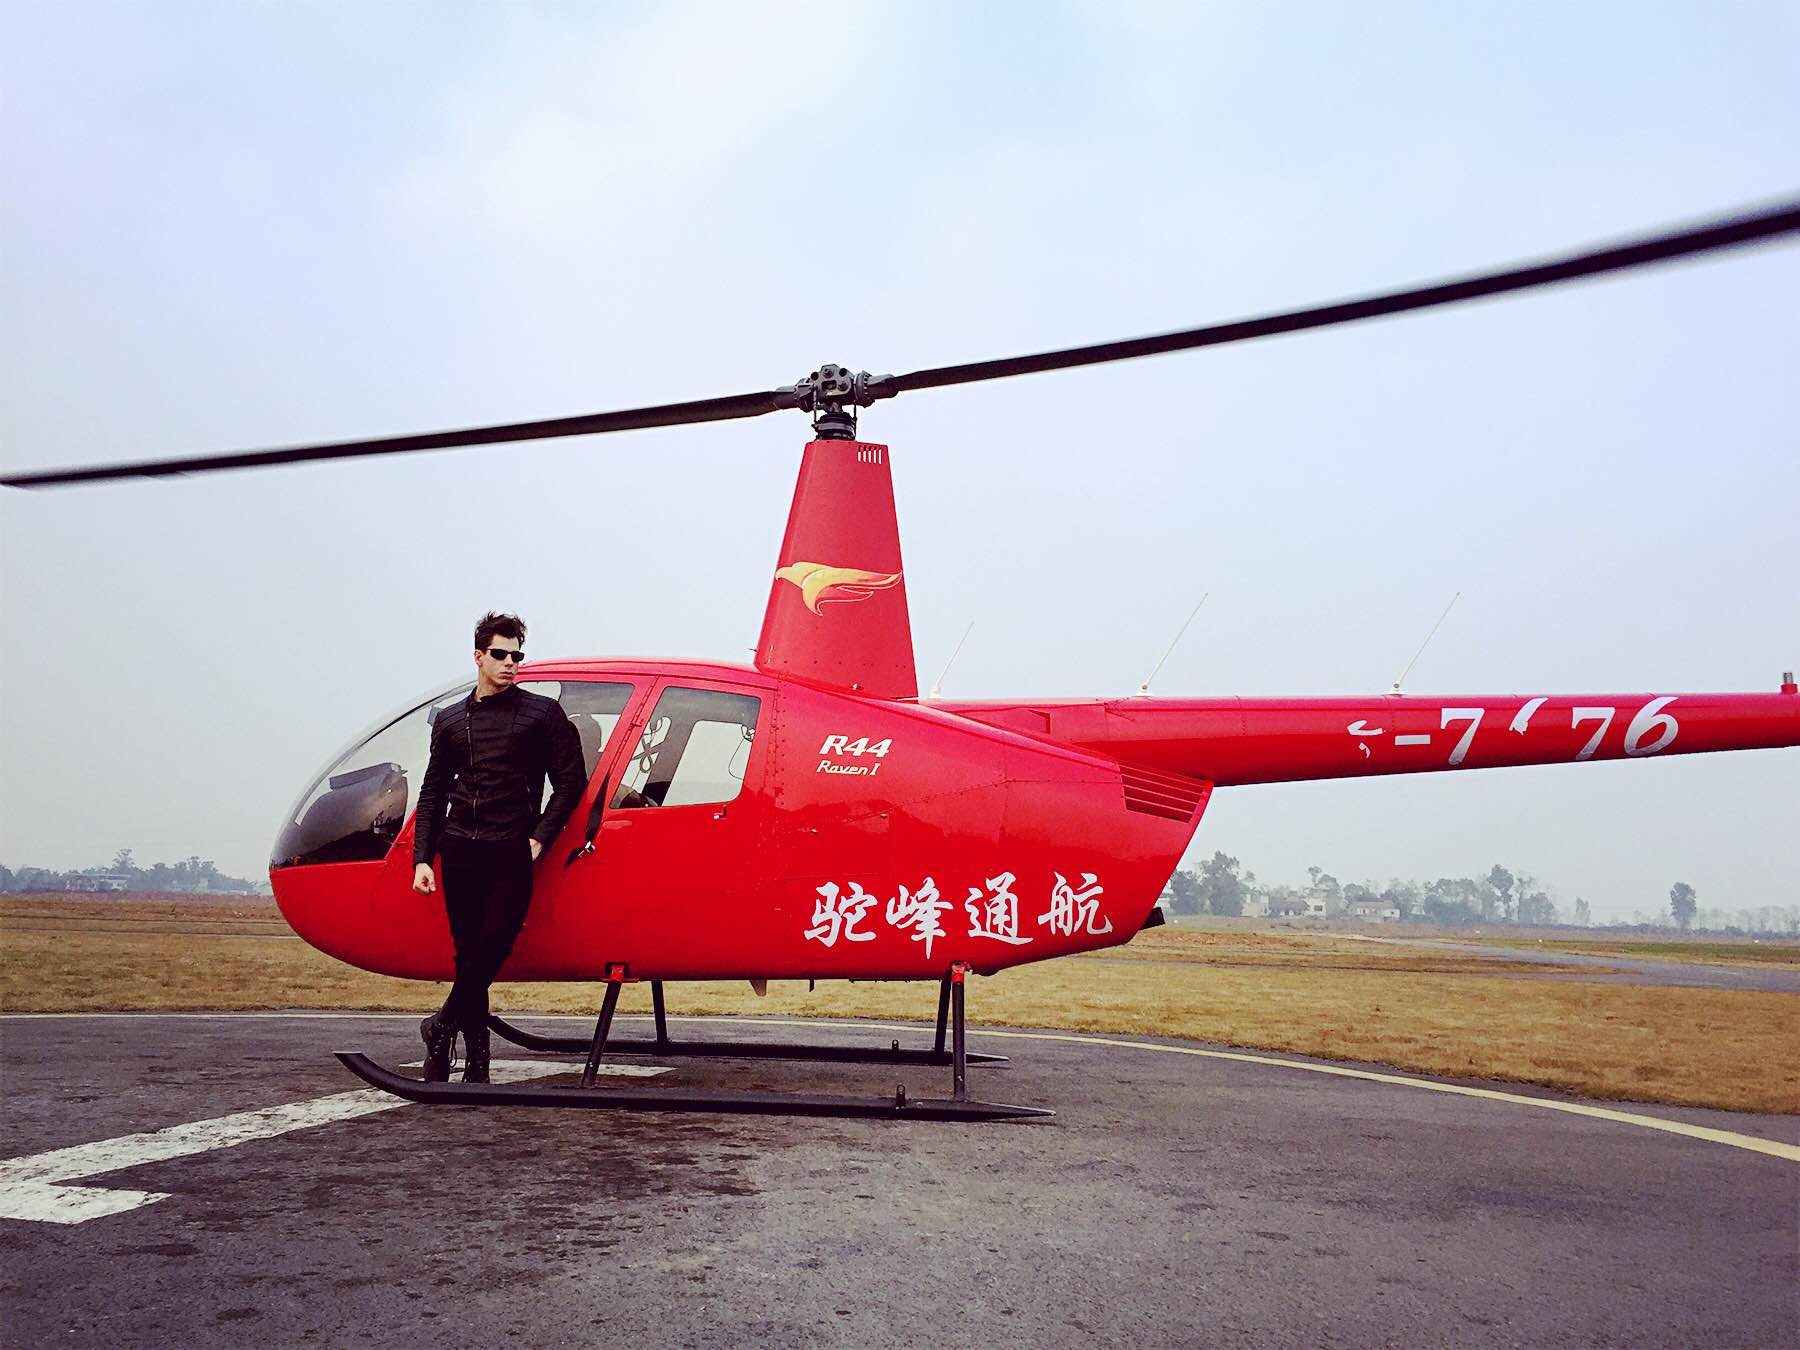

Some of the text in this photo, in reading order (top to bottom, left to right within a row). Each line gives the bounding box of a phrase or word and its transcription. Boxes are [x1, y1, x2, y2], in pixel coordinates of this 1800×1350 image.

[818, 734, 893, 758] R44
[816, 759, 869, 776] Raven
[803, 871, 1113, 960] 驼峰通航
